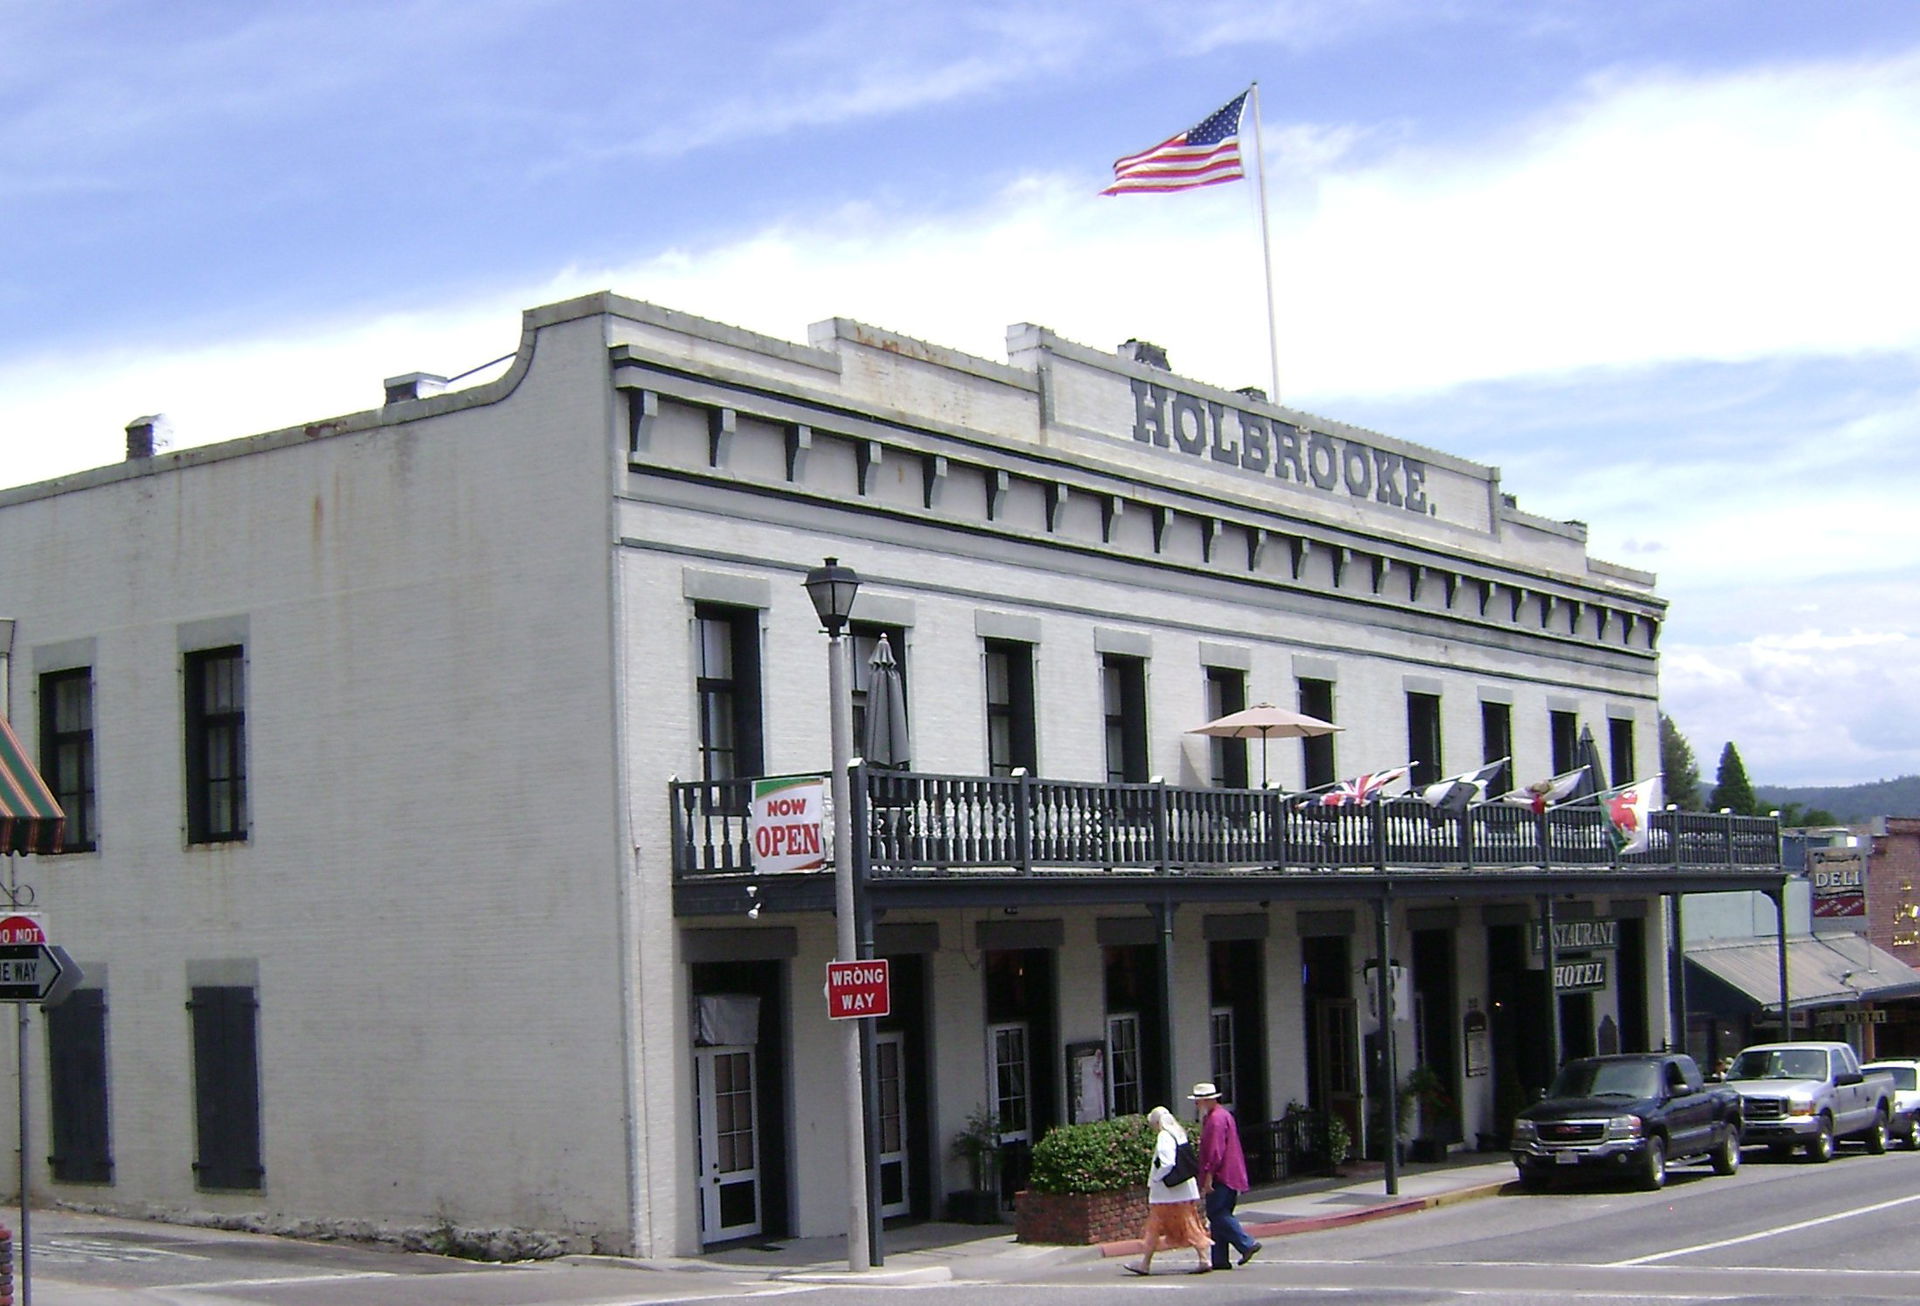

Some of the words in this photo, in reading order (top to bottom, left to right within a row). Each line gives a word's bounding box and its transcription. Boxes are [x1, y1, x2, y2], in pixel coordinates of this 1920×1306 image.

[1131, 377, 1437, 517] HOLBROOKE.
[767, 798, 807, 817] NOW
[756, 823, 821, 858] OPEN
[1815, 871, 1862, 888] DELI
[16, 927, 39, 942] NOT
[1536, 921, 1617, 949] RSTAURANT
[15, 962, 37, 982] WAY
[832, 967, 884, 987] WRONG
[1554, 963, 1604, 988] HOTEL
[842, 993, 876, 1010] WAY
